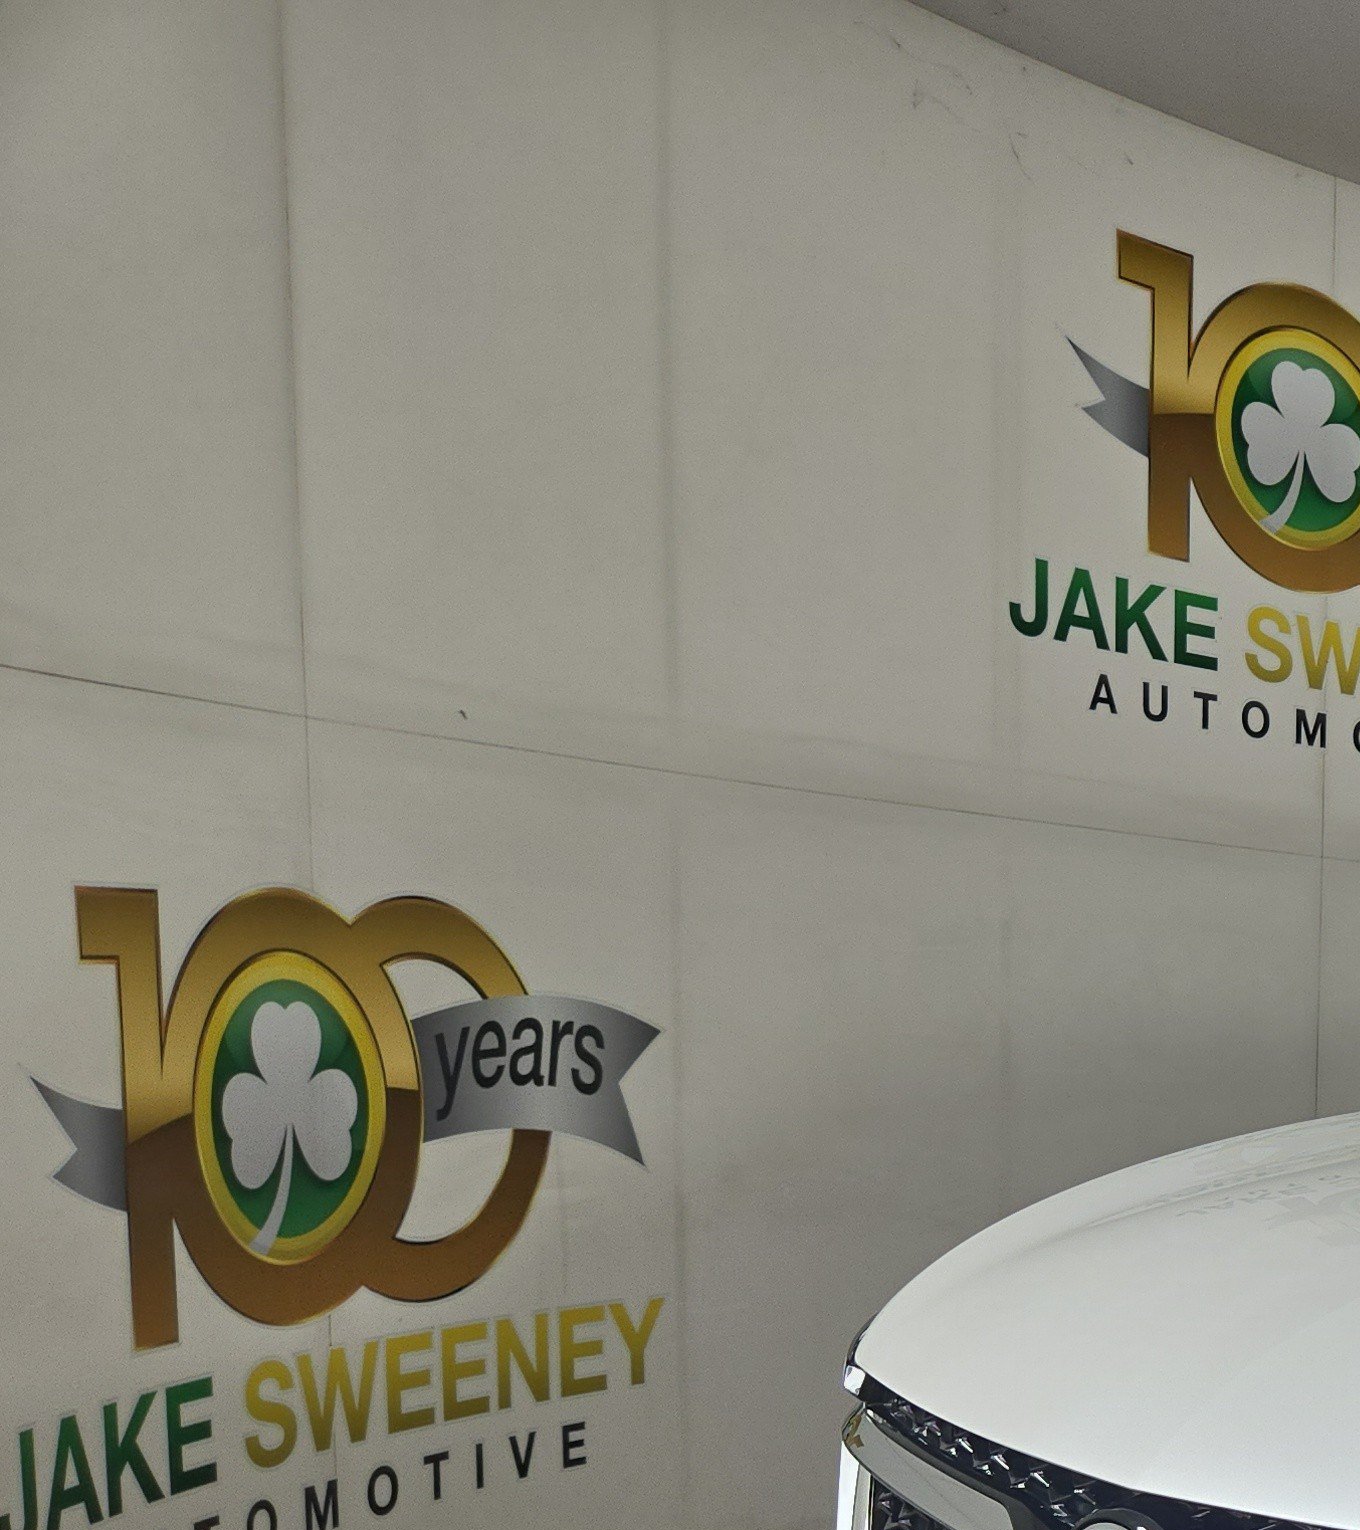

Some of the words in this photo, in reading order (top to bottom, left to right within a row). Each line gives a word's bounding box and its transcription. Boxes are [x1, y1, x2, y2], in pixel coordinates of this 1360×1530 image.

[1009, 558, 1219, 671] JAKE
[434, 1016, 606, 1121] years
[244, 1297, 665, 1469] SWEENEY
